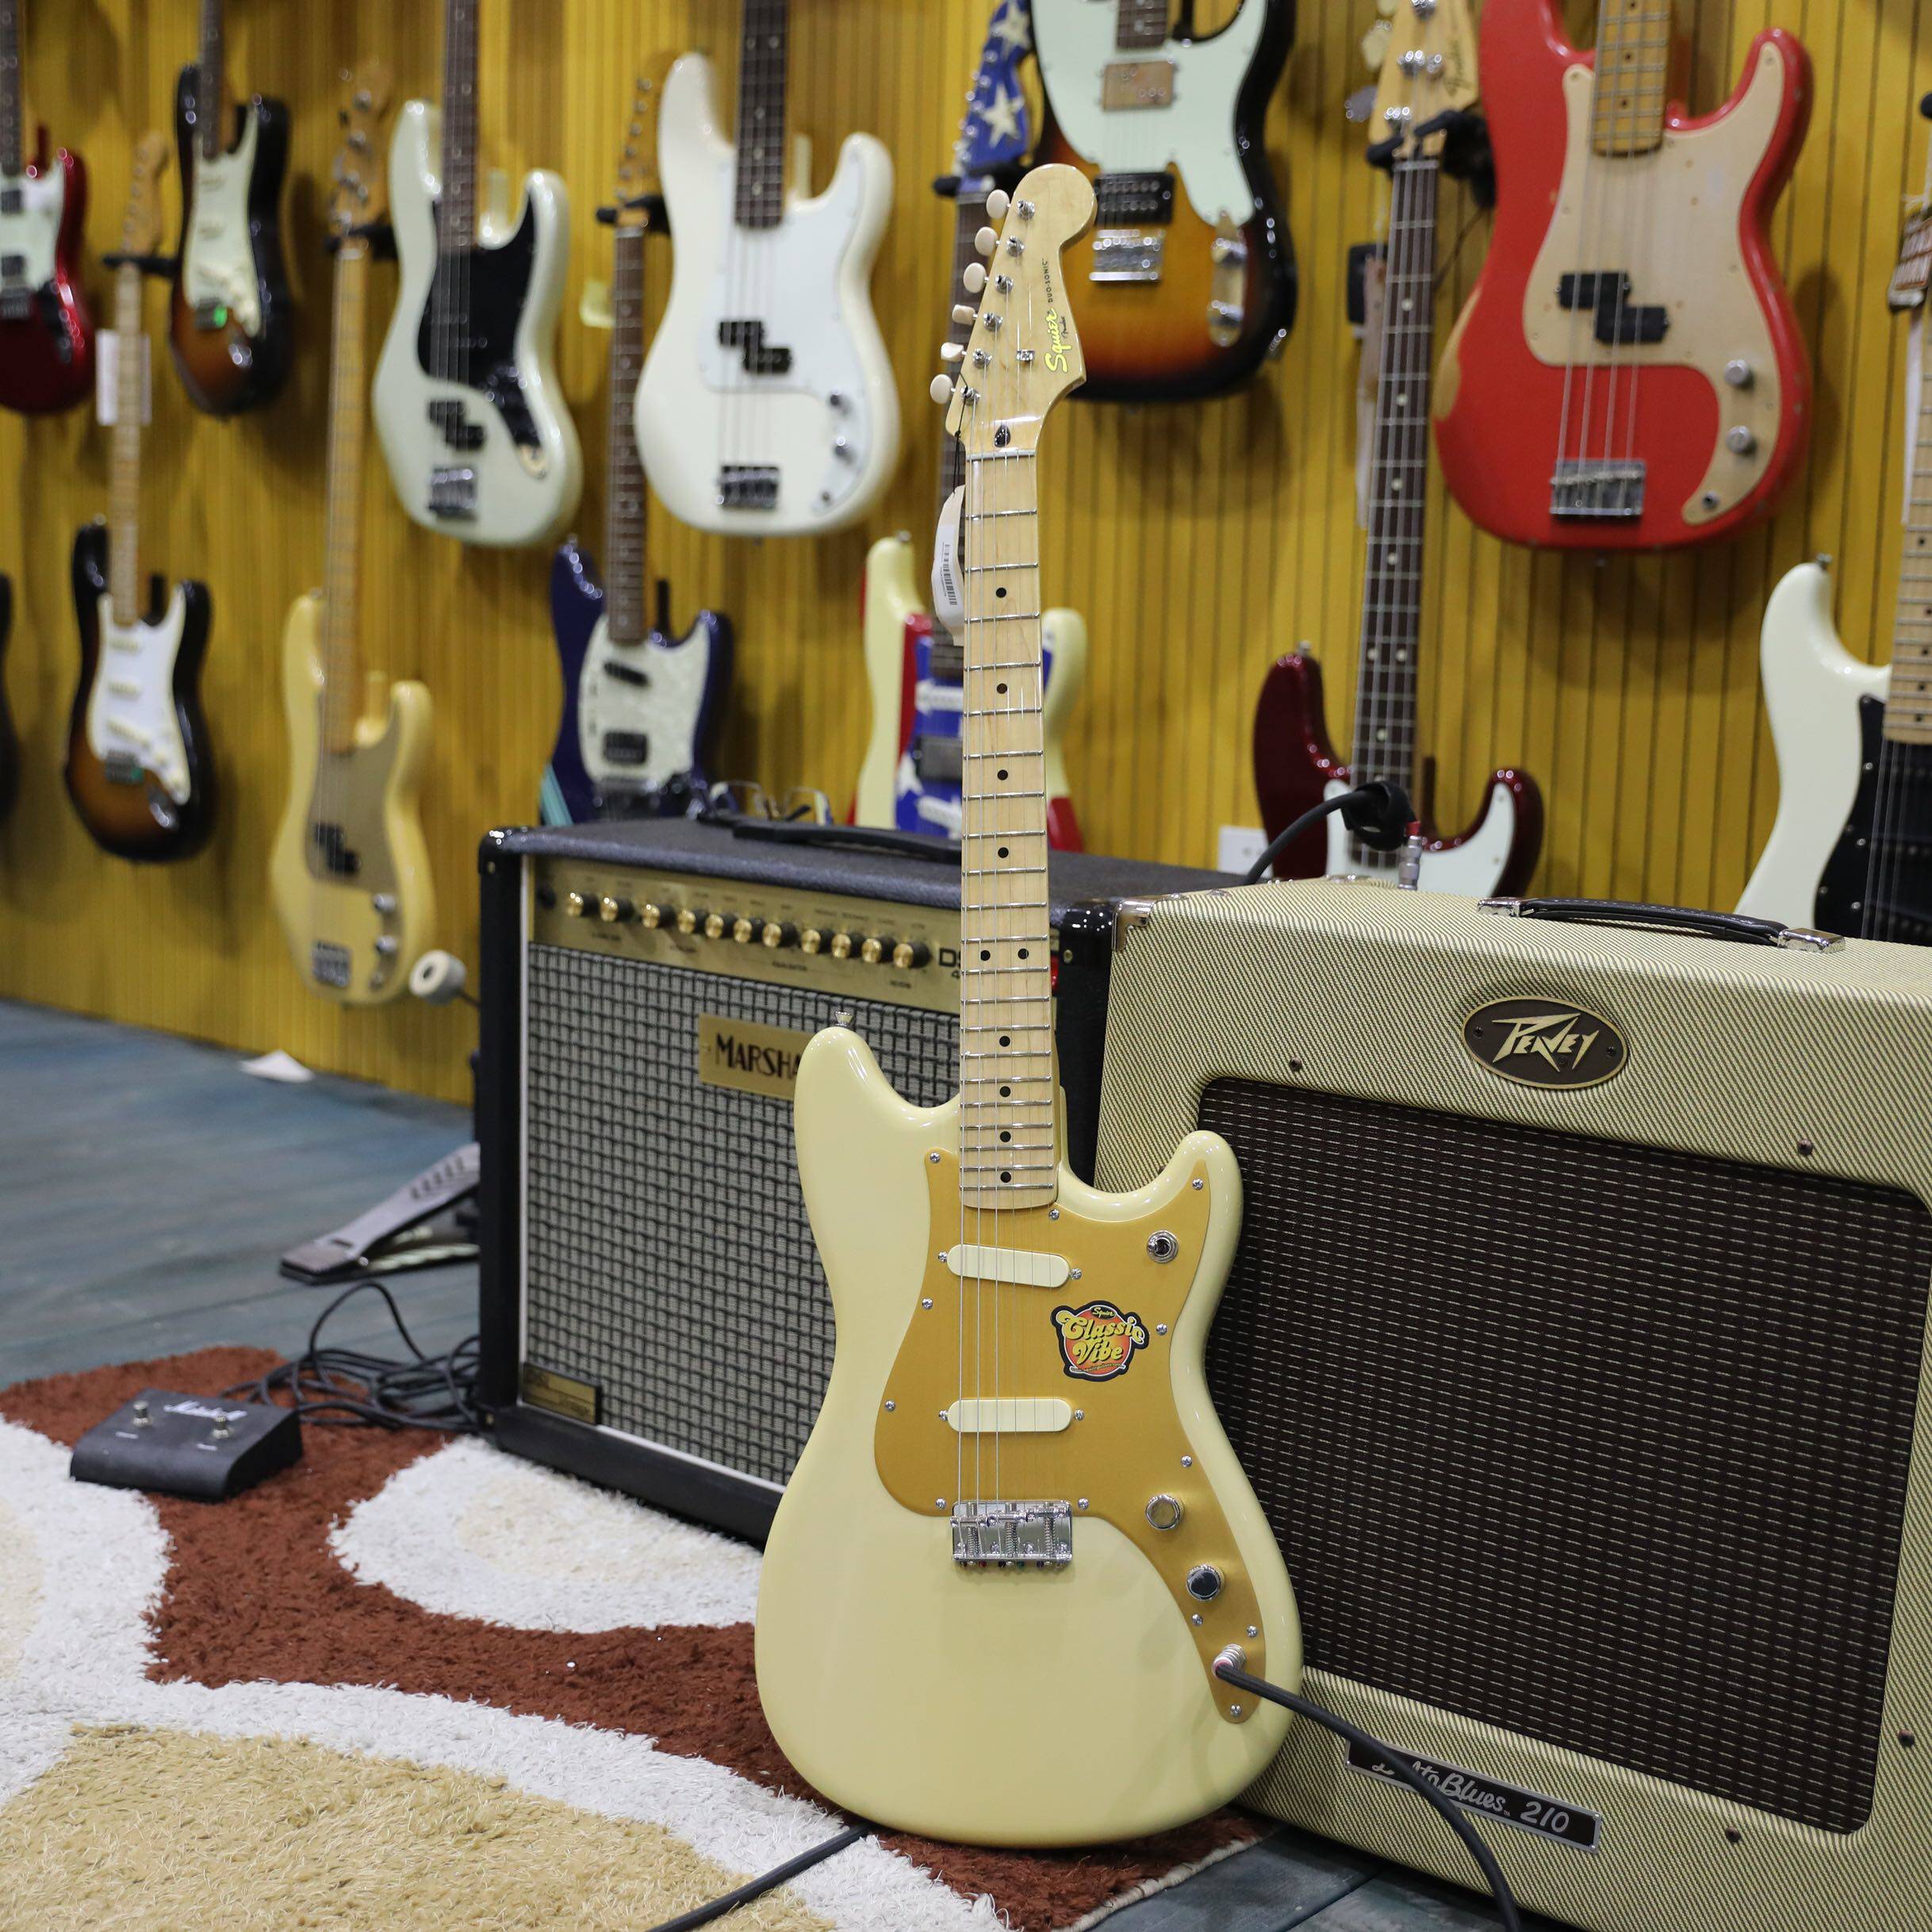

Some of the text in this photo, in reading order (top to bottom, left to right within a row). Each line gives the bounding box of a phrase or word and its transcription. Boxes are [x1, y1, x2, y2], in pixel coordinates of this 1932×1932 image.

[1045, 308, 1072, 373] Squier
[715, 1032, 802, 1079] MARSHA
[1056, 1310, 1144, 1343] Classic
[1072, 1337, 1123, 1365] Vibe
[1520, 1800, 1570, 1833] 210
